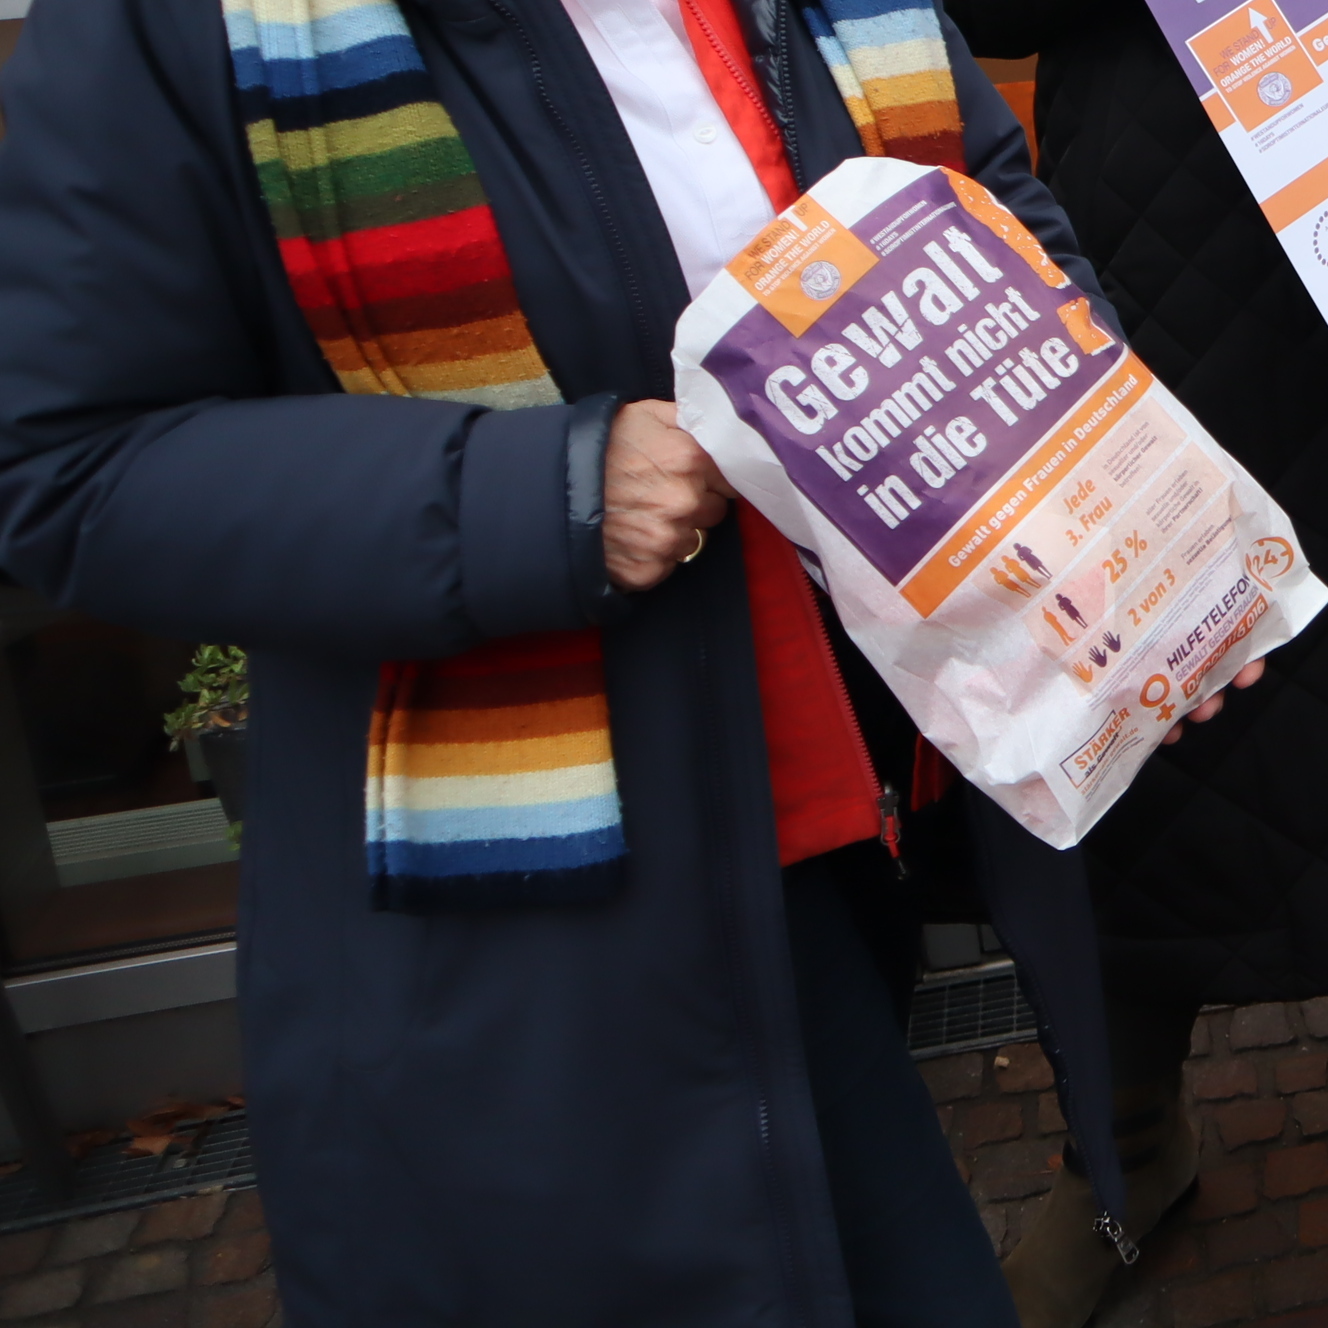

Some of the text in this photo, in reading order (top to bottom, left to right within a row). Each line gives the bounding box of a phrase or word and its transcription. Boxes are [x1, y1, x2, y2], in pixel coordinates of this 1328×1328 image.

[754, 219, 834, 291] ORANGE THE WORLD
[760, 228, 800, 264] WOMEN!
[766, 228, 1000, 433] Gewalt
[816, 287, 1039, 479] kommt nicht
[857, 337, 1078, 528] in die Tüte
[948, 373, 1138, 566] Gewalt gegen Frauen in Deutschland
[1059, 475, 1098, 516] Jede
[1063, 496, 1112, 548] 3. Frau
[1098, 528, 1150, 584] 25 %
[1124, 566, 1178, 628] 2 von 3
